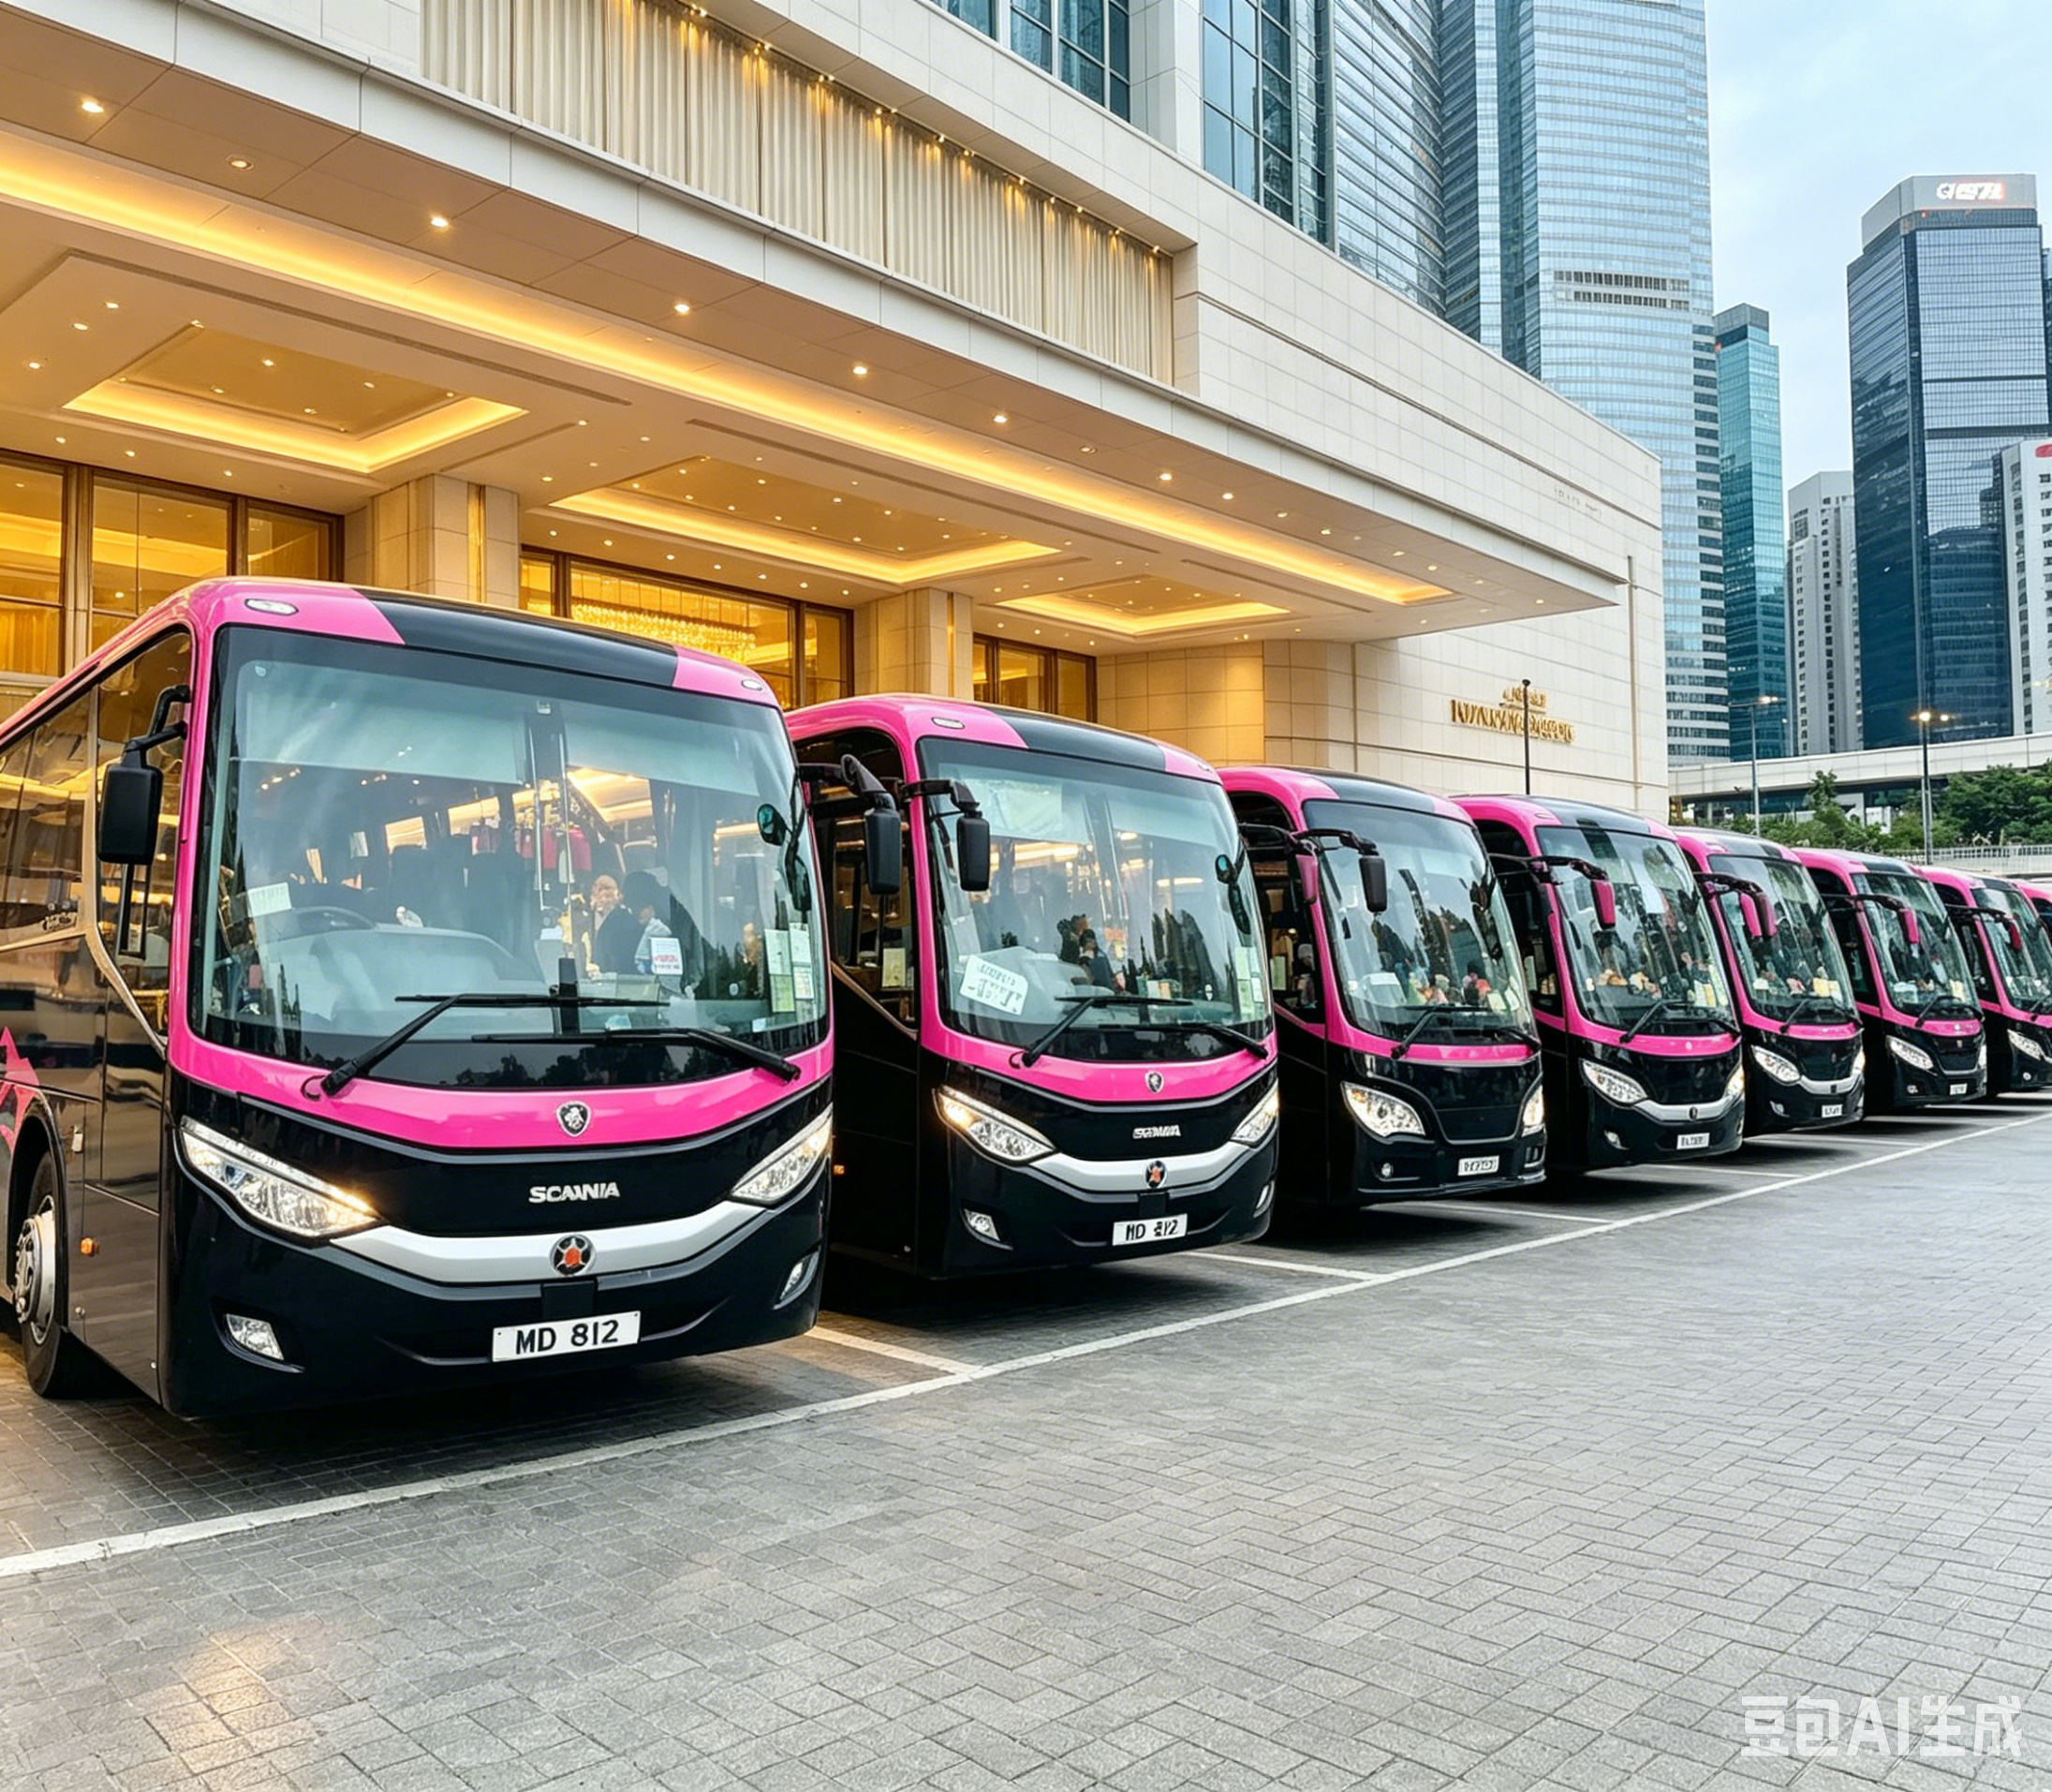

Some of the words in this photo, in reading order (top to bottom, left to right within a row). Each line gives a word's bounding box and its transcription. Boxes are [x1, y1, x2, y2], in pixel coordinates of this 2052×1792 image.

[528, 1182, 620, 1204] SCANIA
[516, 1327, 556, 1355] MD
[570, 1320, 619, 1347] 812
